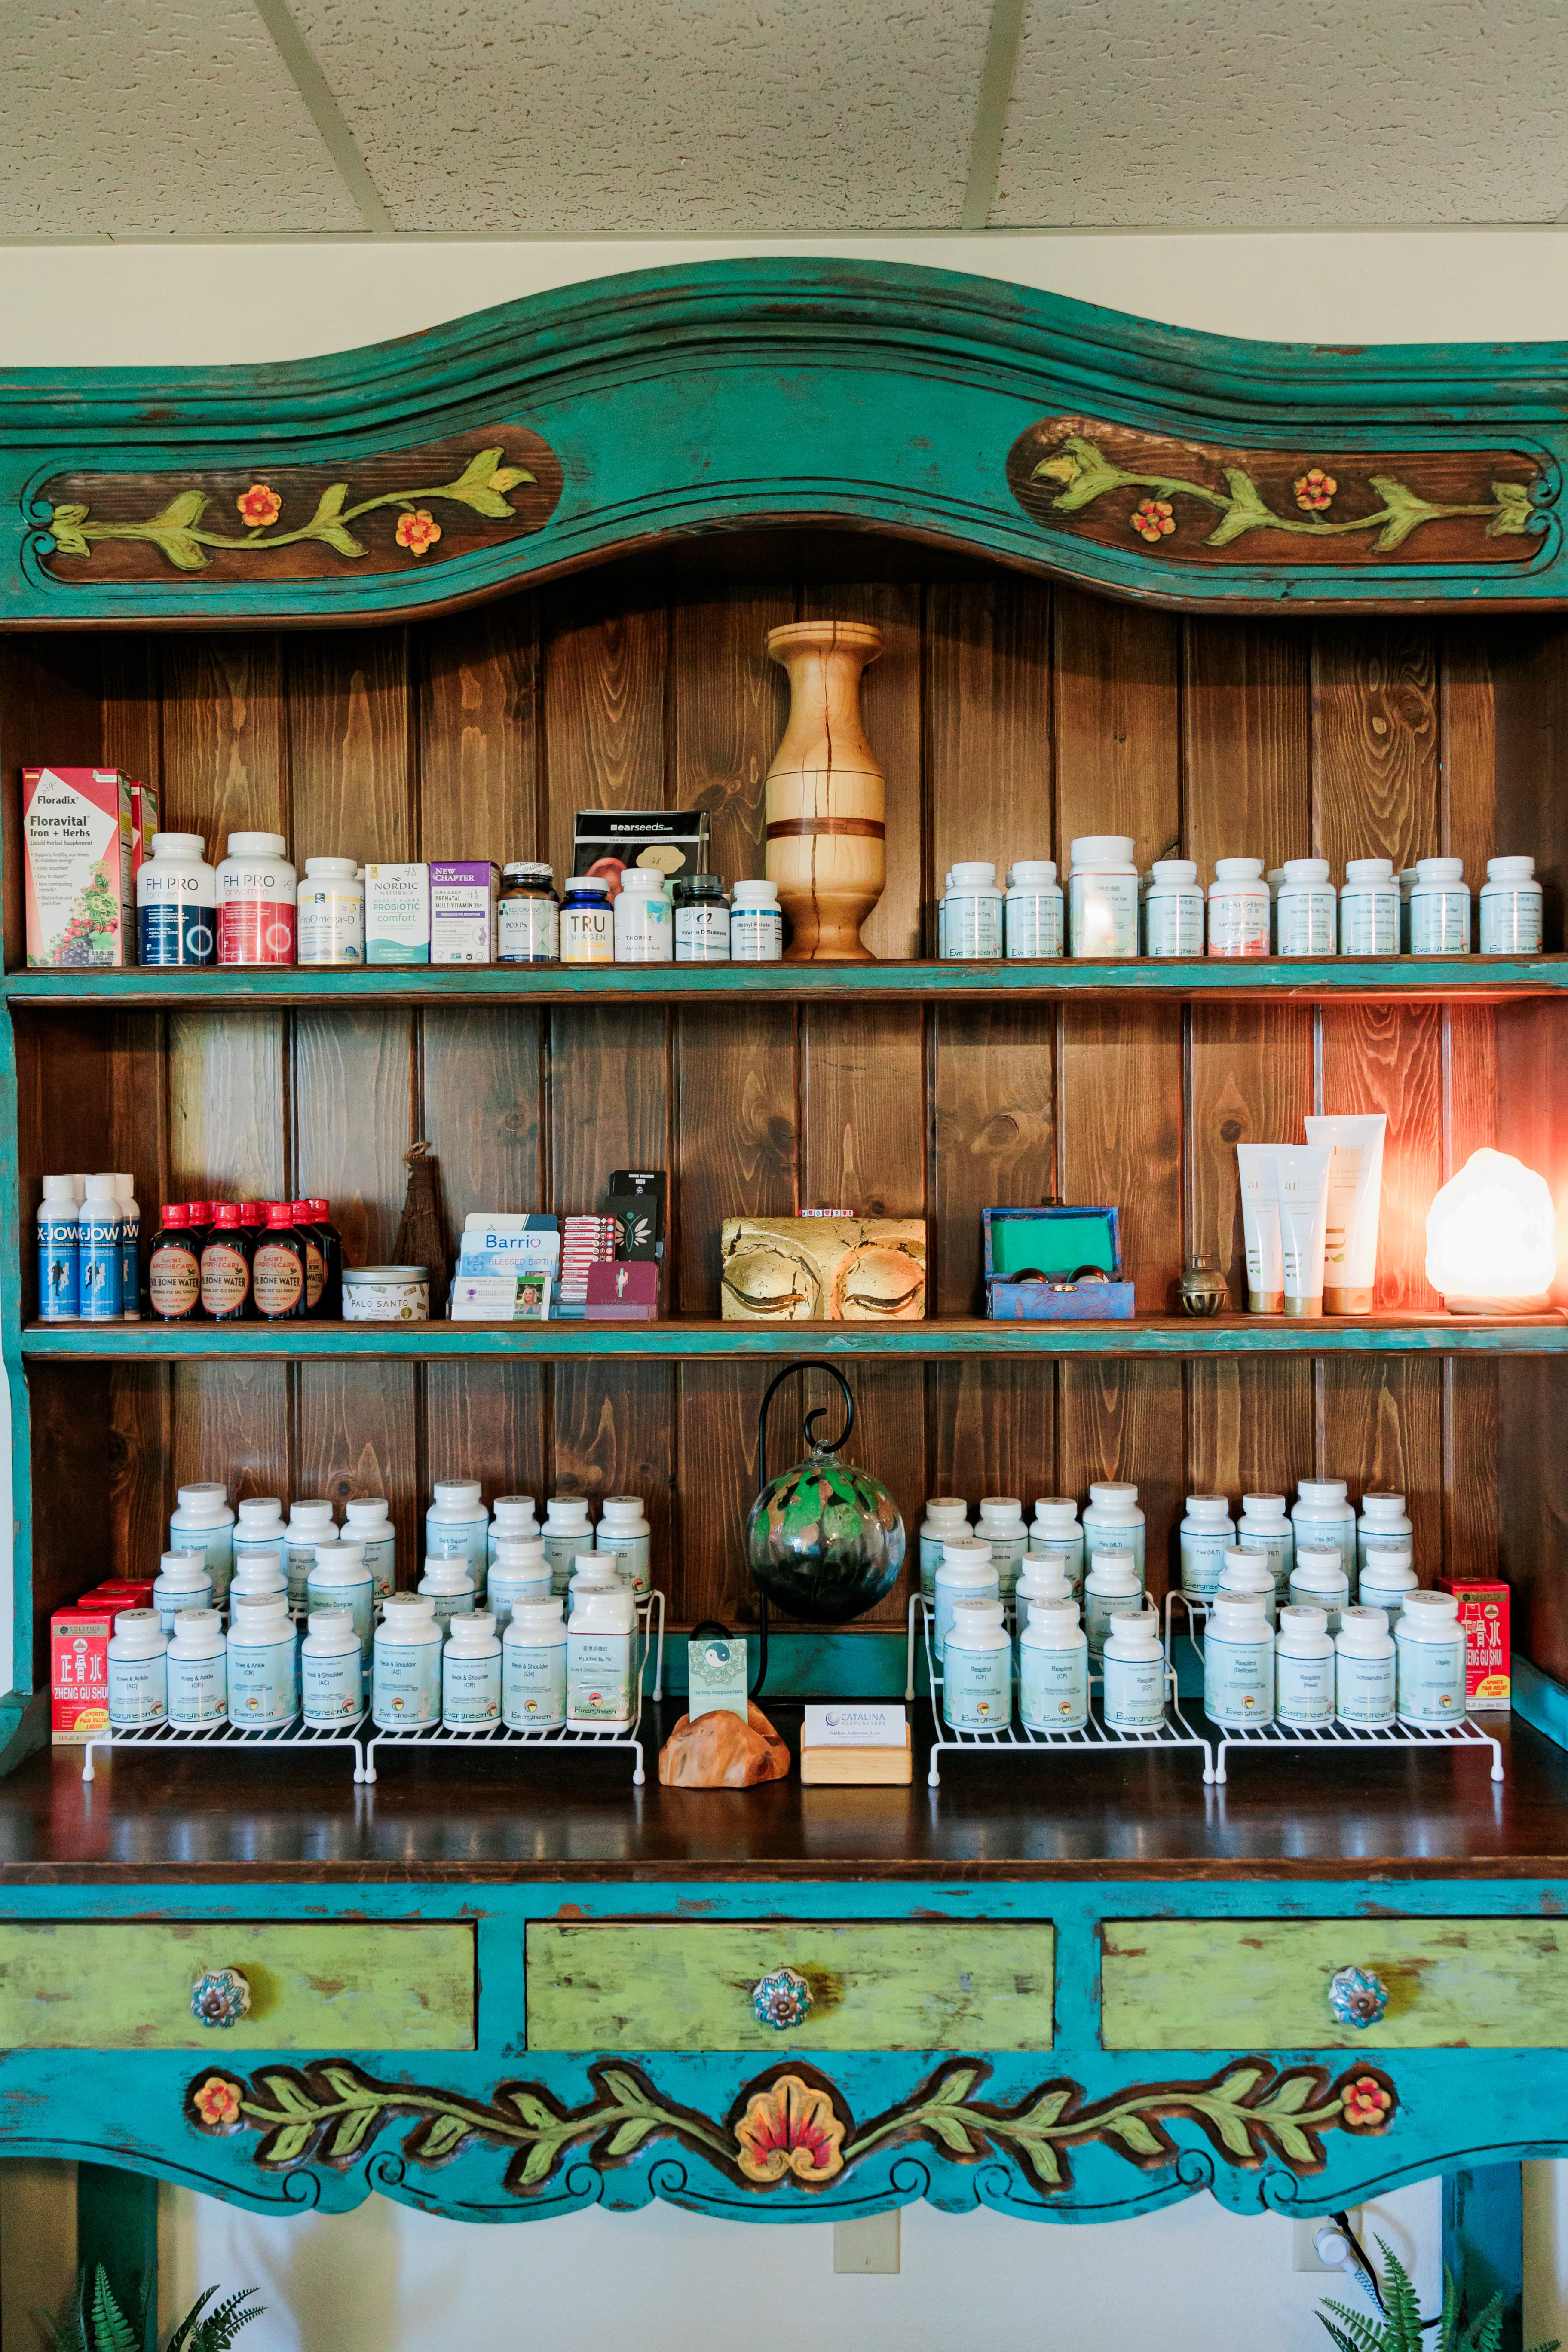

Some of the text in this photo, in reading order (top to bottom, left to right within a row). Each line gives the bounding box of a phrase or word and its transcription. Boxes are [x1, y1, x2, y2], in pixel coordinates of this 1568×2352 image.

[618, 823, 672, 831] earseeds.com
[147, 879, 162, 890] FH
[224, 876, 238, 887] FH
[571, 916, 605, 932] TRU
[178, 1278, 199, 1288] WATER
[224, 1277, 245, 1288] WATER
[280, 1277, 300, 1287] WATER
[1480, 1649, 1502, 1665] GU SHUI
[61, 1654, 101, 1682] 正骨水
[54, 1687, 90, 1699] ZHENG GU
[171, 1709, 214, 1719] Evergreen
[234, 1709, 273, 1718] Evergreen
[379, 1709, 418, 1718] Evergreen
[444, 1708, 486, 1719] Evergreen
[511, 1712, 551, 1721] Evergreen
[1280, 1706, 1326, 1718] Evergreen
[1343, 1706, 1389, 1718] Evergreen
[962, 1715, 1001, 1723] Evergreen
